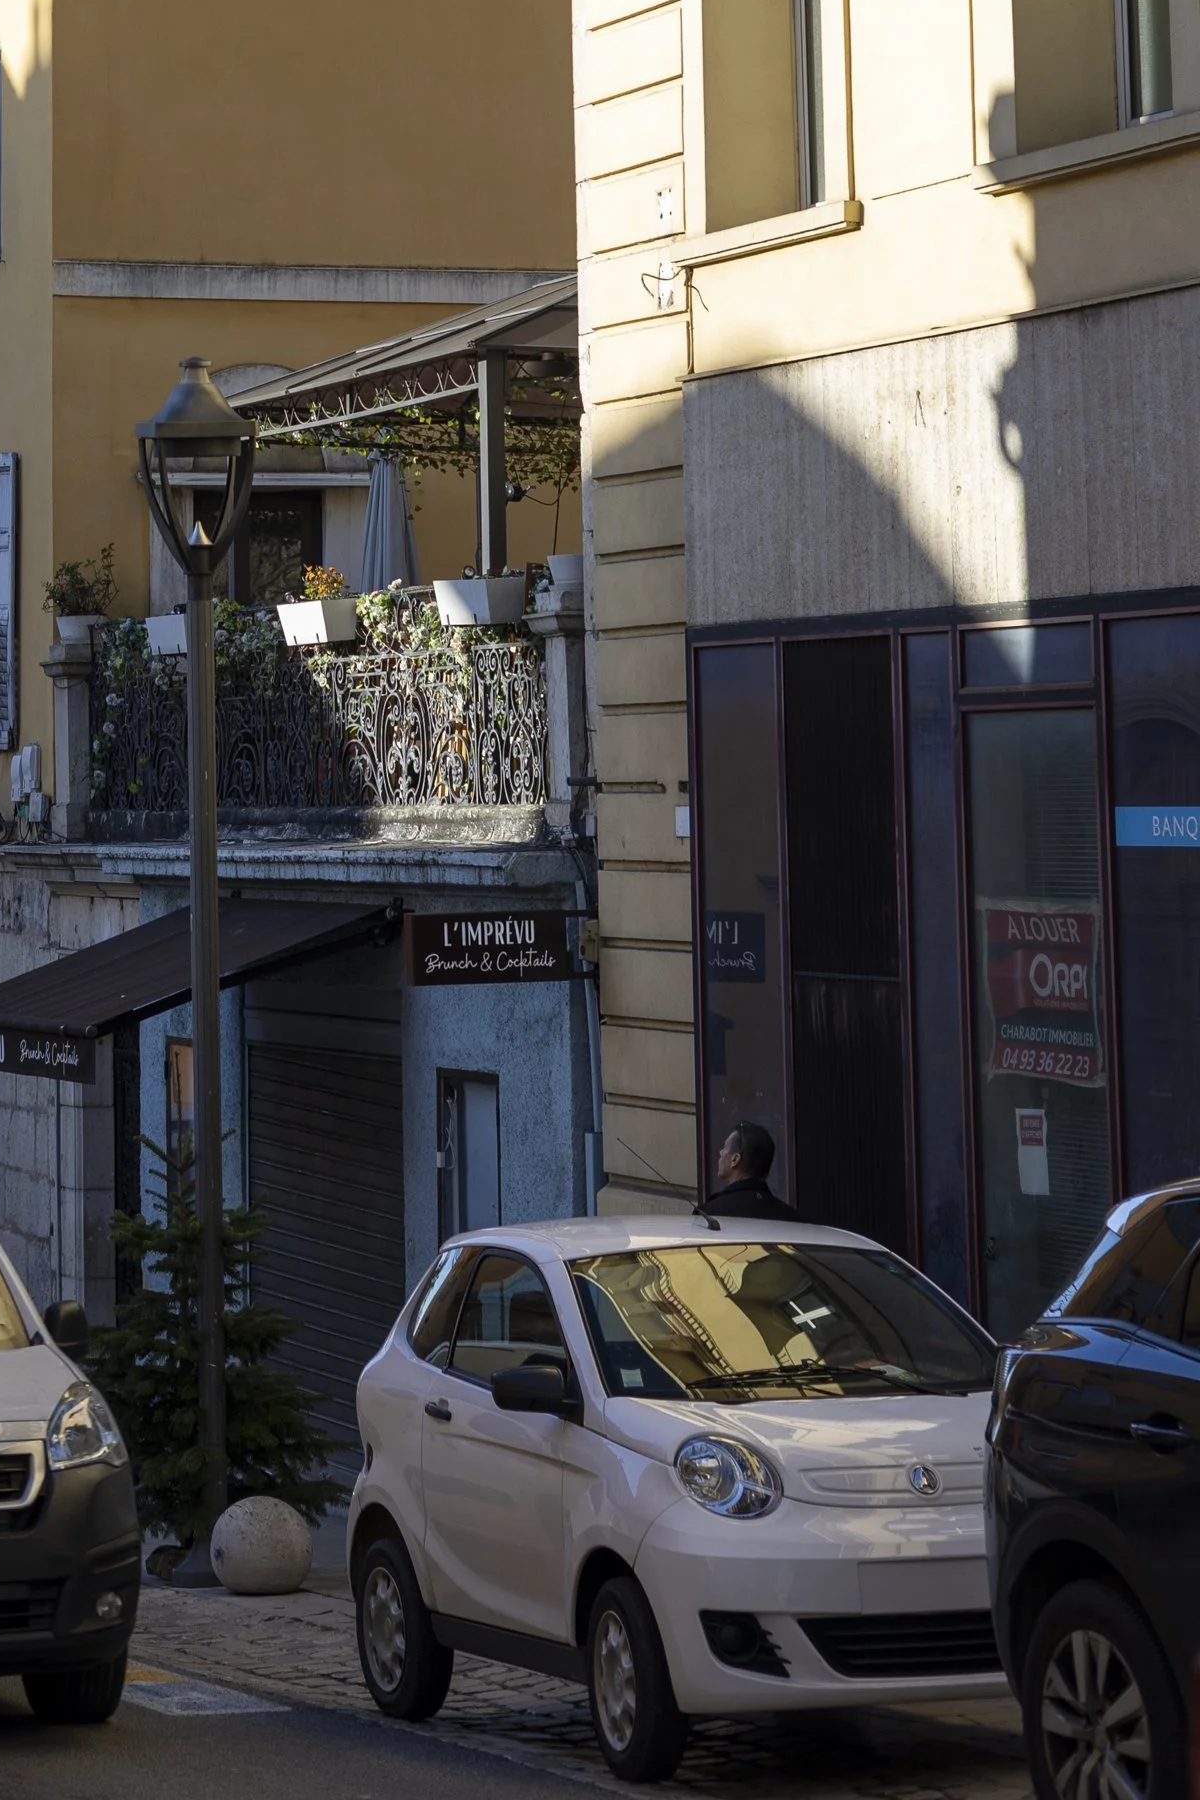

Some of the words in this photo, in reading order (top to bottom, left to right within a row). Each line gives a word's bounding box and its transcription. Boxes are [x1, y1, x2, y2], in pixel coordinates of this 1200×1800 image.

[443, 915, 535, 947] L'IMPRÉVU
[1007, 915, 1021, 940] A
[1022, 916, 1080, 943] LOUER
[424, 952, 478, 974] Brunch
[480, 951, 493, 972] &
[496, 947, 556, 978] Cocktails
[1029, 952, 1088, 999] ORPI
[1001, 1023, 1047, 1042] CHARABOT
[1048, 1030, 1094, 1047] IMMOBILIER
[44, 1041, 51, 1065] &
[1002, 1047, 1018, 1069] 04
[1019, 1049, 1036, 1070] 93
[1036, 1050, 1054, 1072] 36
[1054, 1052, 1072, 1075] 22
[1074, 1055, 1090, 1077] 23
